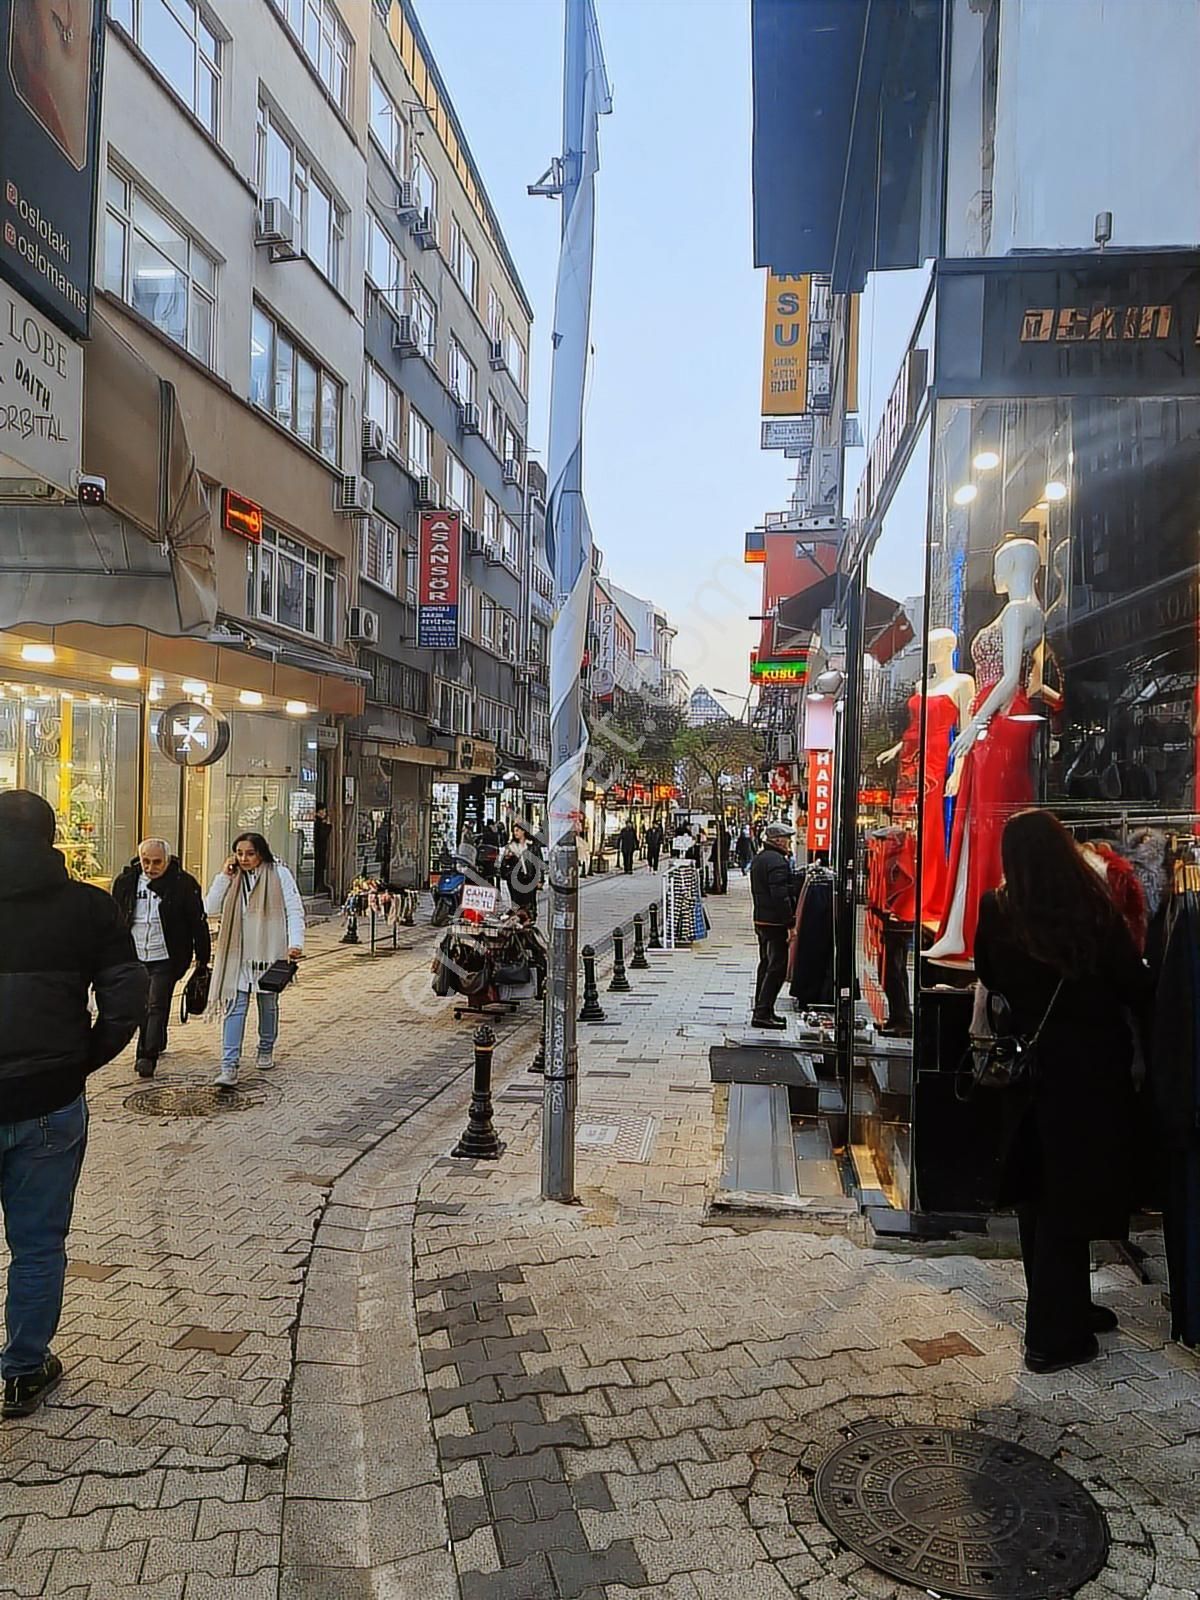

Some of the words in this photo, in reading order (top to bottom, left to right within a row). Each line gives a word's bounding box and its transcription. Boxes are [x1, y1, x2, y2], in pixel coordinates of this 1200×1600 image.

[19, 199, 71, 264] oslotaki
[18, 235, 88, 315] oslomanns
[8, 301, 67, 379] LOBE
[15, 358, 51, 412] DAITH
[428, 521, 450, 601] ASANSÖR
[815, 752, 830, 847] HARPUT
